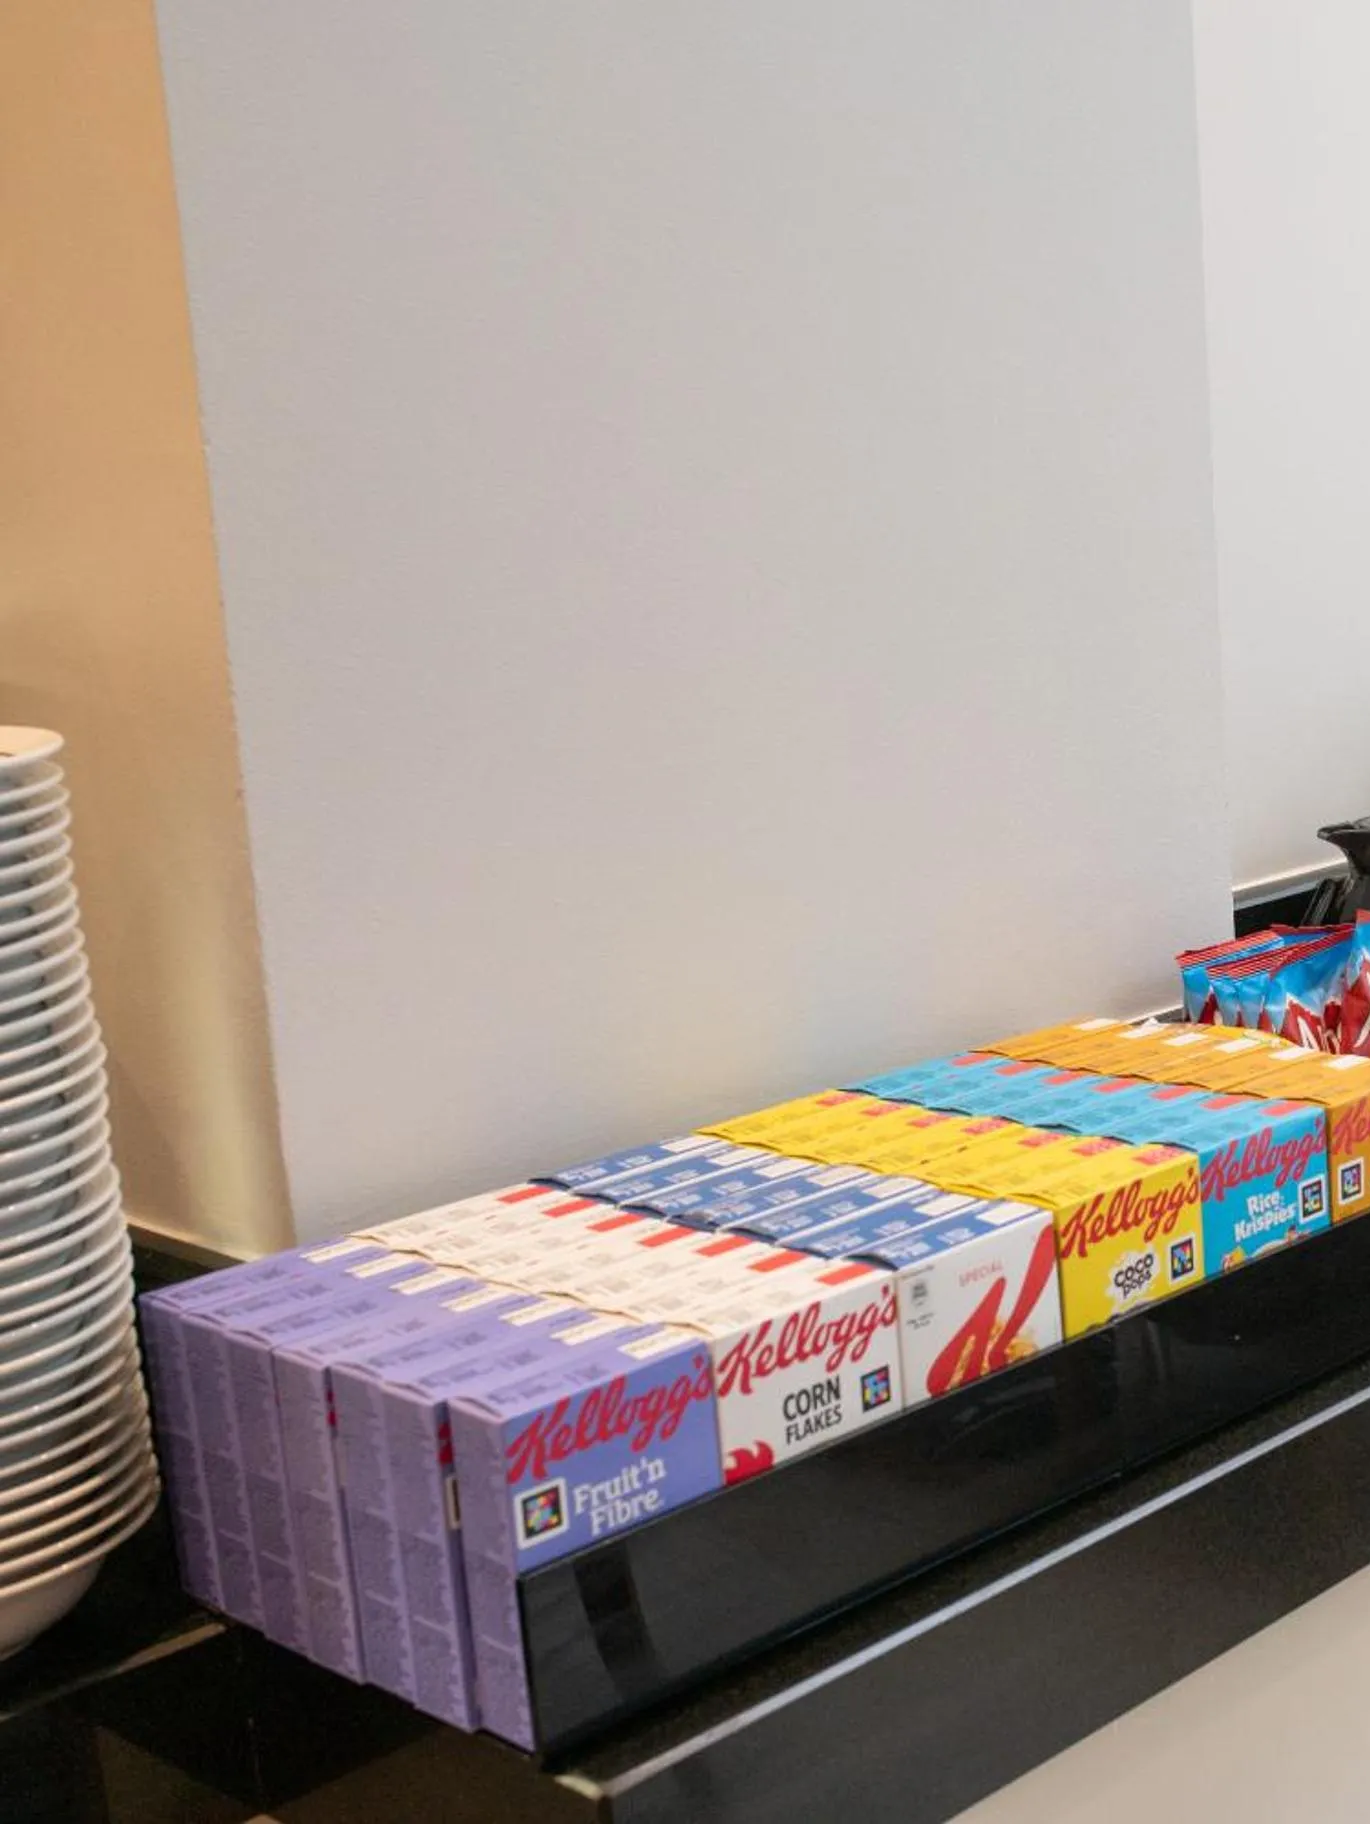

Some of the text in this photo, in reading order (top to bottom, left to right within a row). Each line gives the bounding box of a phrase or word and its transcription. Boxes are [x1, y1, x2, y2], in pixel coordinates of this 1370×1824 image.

[1200, 1117, 1327, 1203] Kellogg's
[1060, 1167, 1199, 1260] Kellogg's
[717, 1284, 898, 1399] Kellogg's
[505, 1354, 714, 1485] Kellogg's
[782, 1374, 842, 1422] CORN
[785, 1403, 844, 1446] FLAKES
[590, 1488, 662, 1537] Fibre
